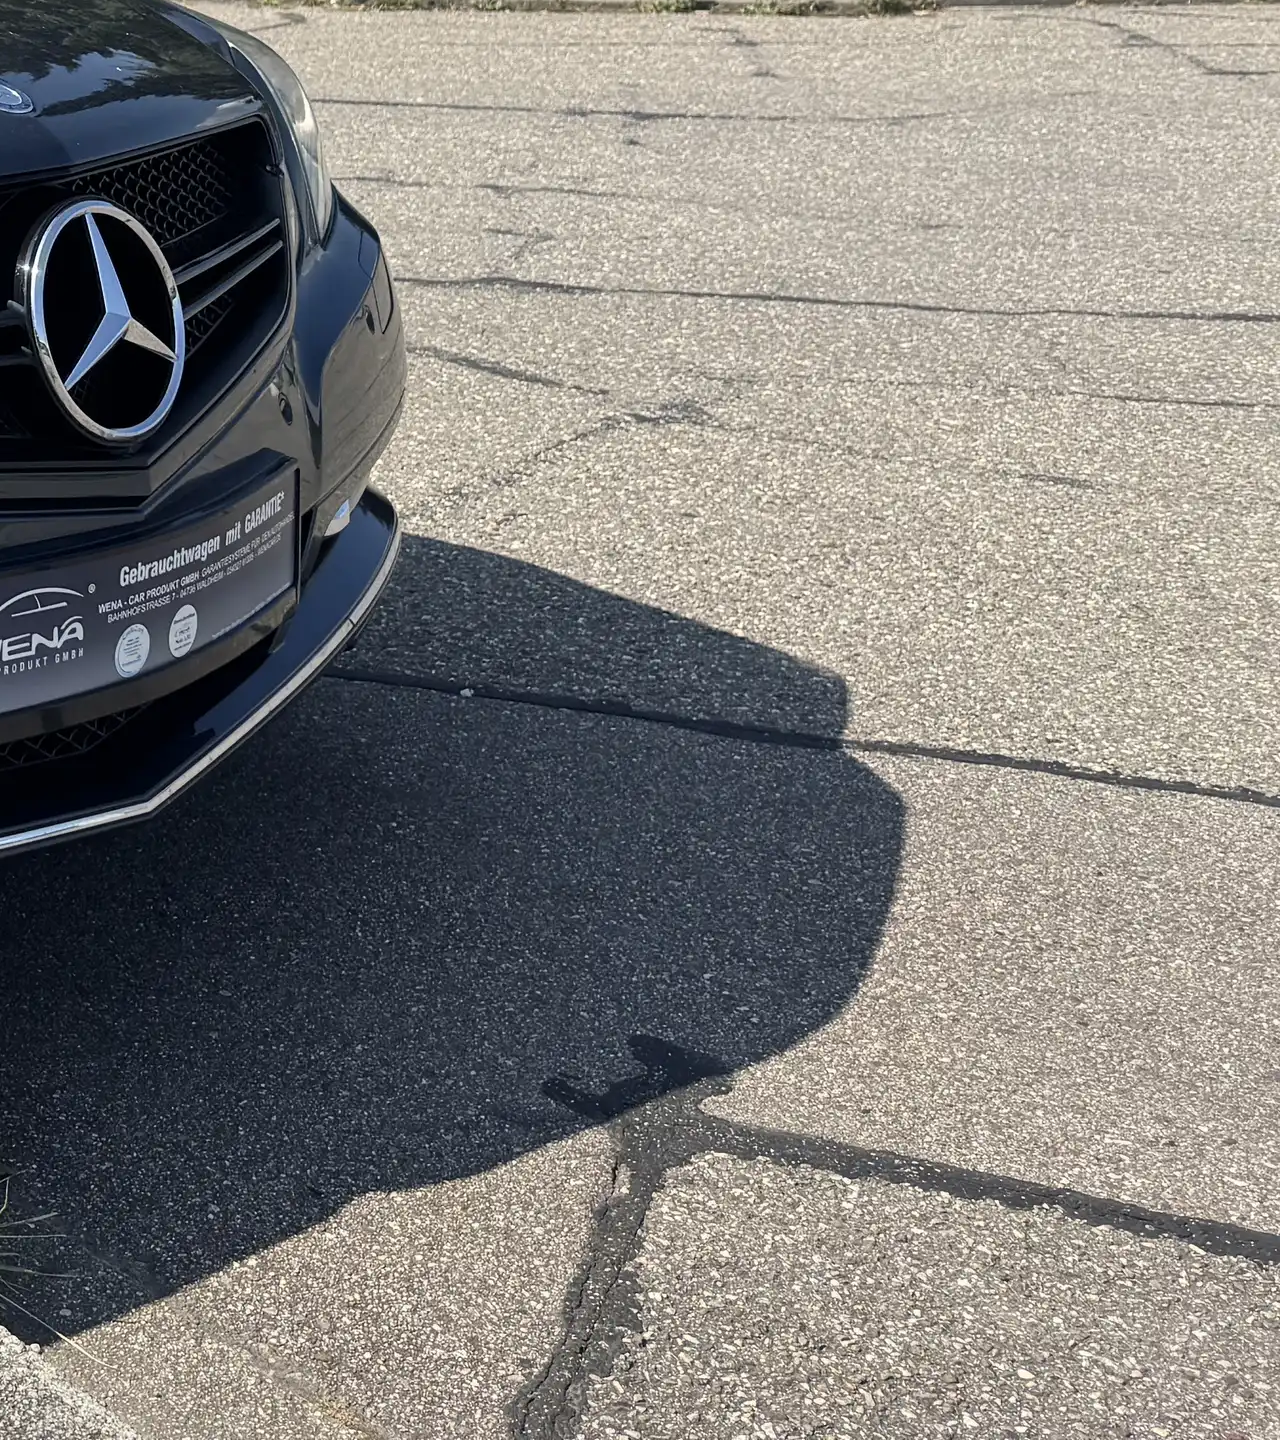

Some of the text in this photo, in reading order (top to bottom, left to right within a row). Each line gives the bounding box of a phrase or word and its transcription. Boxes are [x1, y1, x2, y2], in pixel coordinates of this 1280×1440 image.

[119, 535, 221, 588] Gebrauchtwagen
[225, 520, 242, 546] mit
[128, 591, 145, 606] CAR
[145, 578, 180, 600] PRODUKT
[54, 647, 85, 664] GMBH
